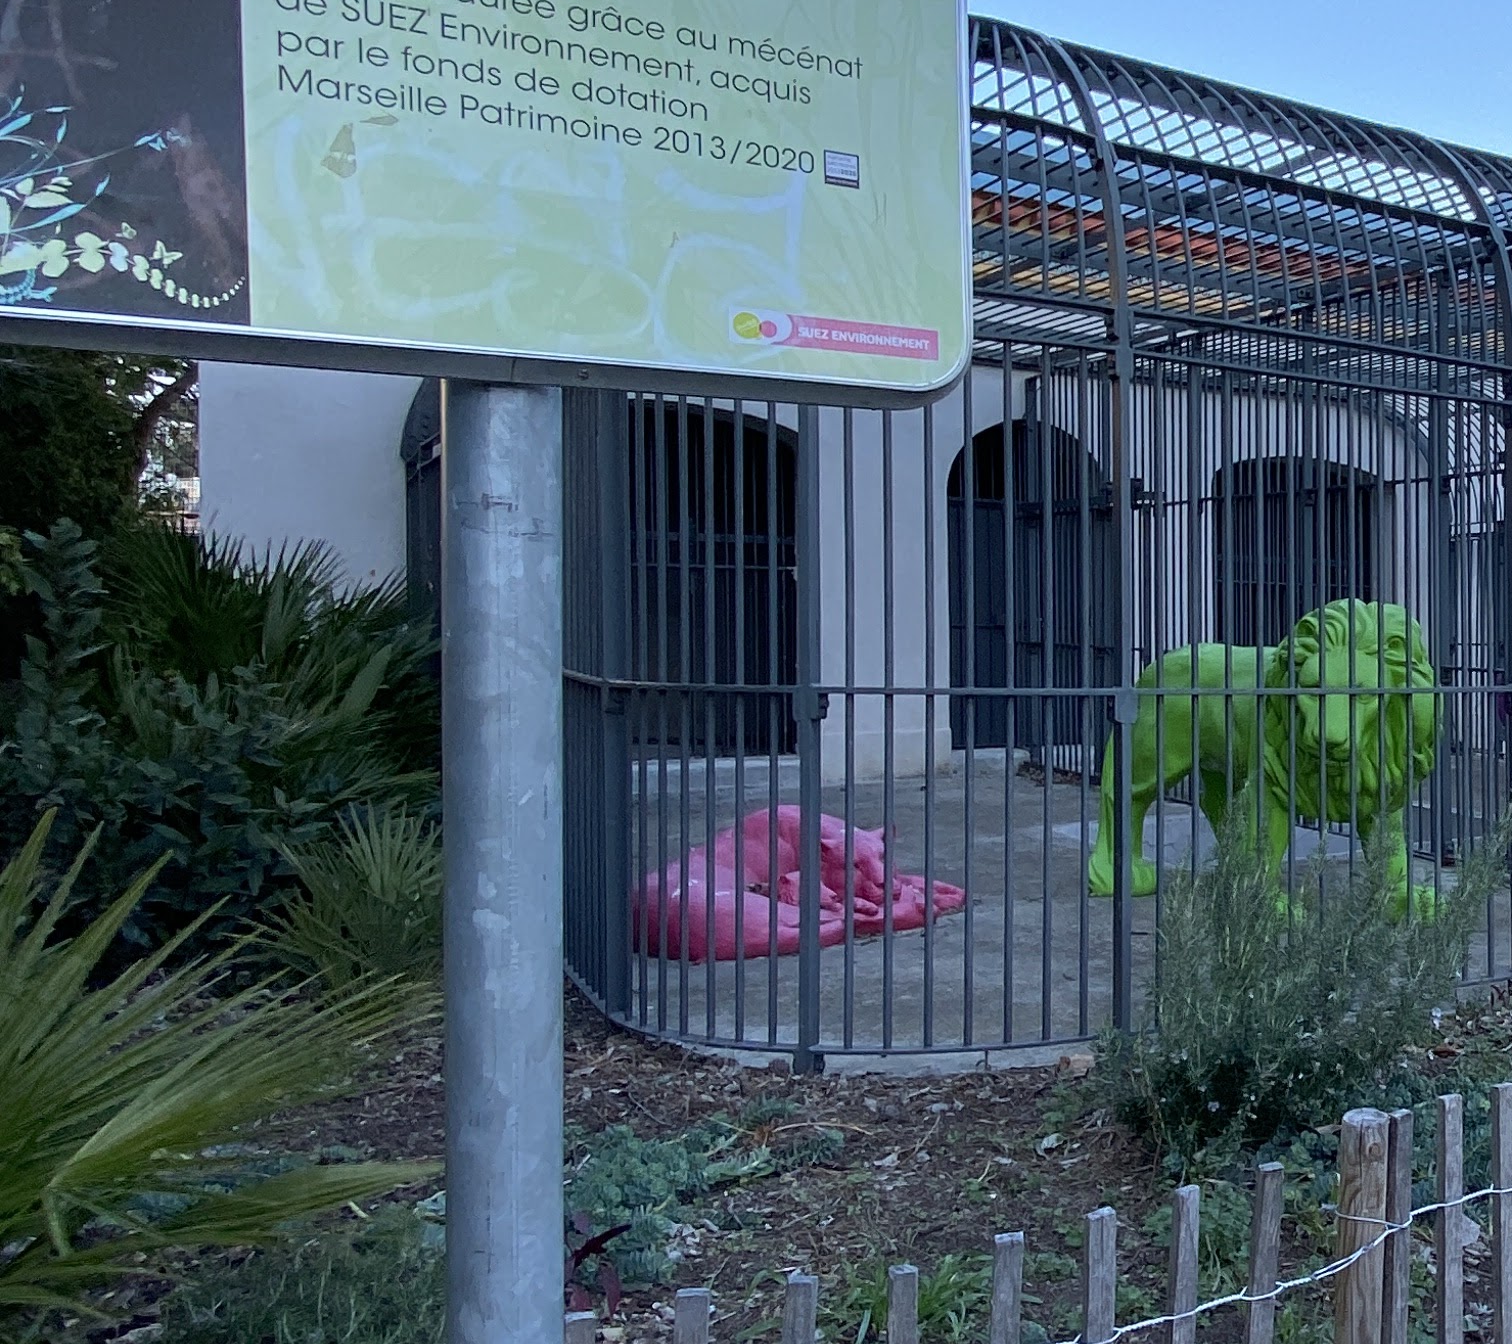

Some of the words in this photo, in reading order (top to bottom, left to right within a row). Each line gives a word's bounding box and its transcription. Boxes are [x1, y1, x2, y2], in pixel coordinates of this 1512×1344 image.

[278, 30, 344, 60] par
[358, 37, 389, 67] le
[401, 45, 502, 86] fonds
[514, 67, 560, 95] de
[572, 78, 708, 122] dotation
[440, 12, 701, 86] Environnement,
[710, 69, 811, 104] acquis
[567, 5, 665, 41] grâce
[676, 26, 718, 51] au
[728, 37, 864, 80] mécénat
[278, 64, 447, 116] Marseille
[460, 94, 643, 147] Patrimoine
[653, 126, 815, 174] 2013/2020
[798, 326, 829, 340] SUEZ
[831, 330, 931, 351] ENVIRONNEMENT
